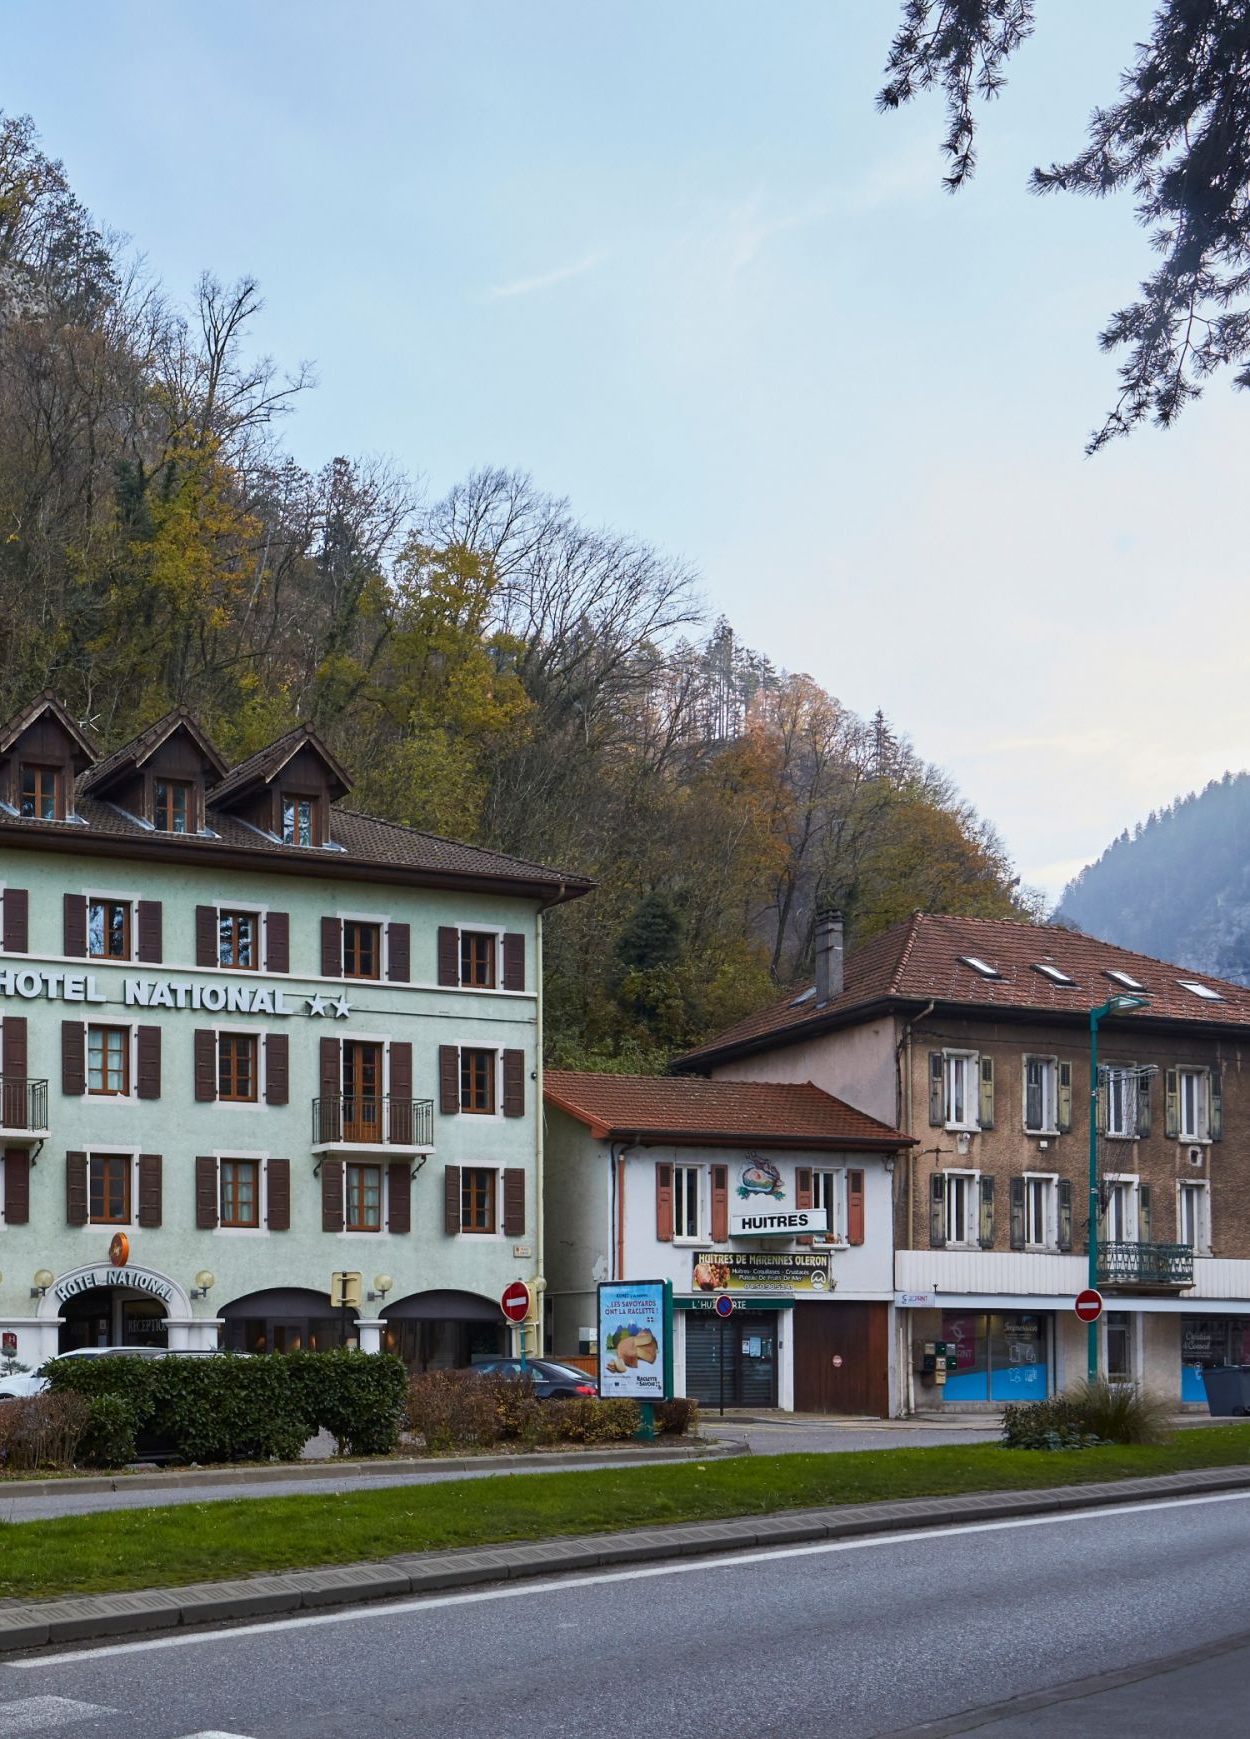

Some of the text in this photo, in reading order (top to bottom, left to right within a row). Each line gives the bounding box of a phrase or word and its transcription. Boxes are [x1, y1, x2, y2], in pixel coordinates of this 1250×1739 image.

[123, 979, 293, 1014] NATIONAL
[741, 1214, 809, 1230] HUITRES
[735, 1254, 747, 1265] DE
[749, 1255, 793, 1266] MARENNES
[55, 1270, 173, 1303] HOTEL NATIONAL
